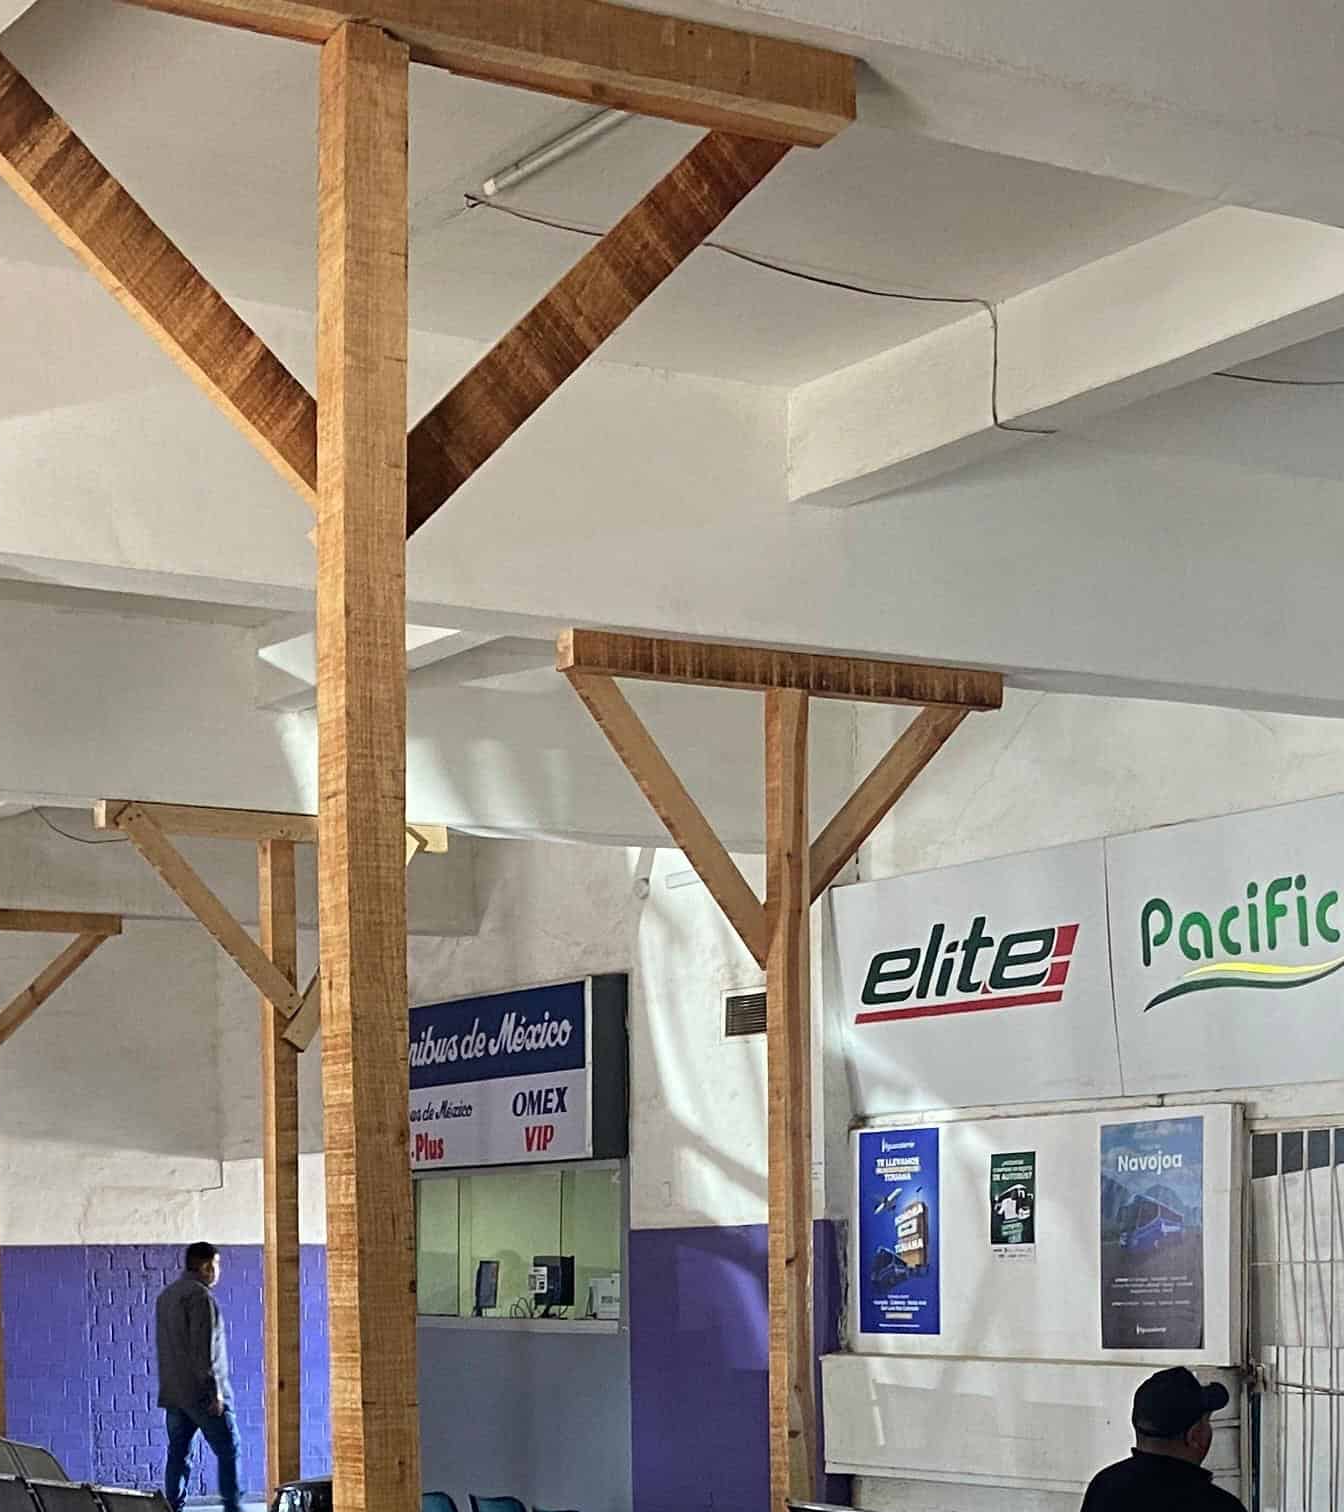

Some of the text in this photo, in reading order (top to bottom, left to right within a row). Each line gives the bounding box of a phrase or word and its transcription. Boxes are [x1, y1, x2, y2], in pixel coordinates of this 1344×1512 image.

[860, 916, 1057, 1006] elite
[409, 1011, 573, 1067] nibus de México
[512, 1086, 568, 1117] OMEX
[525, 1124, 554, 1152] VIP
[1117, 1149, 1183, 1175] Navojoa
